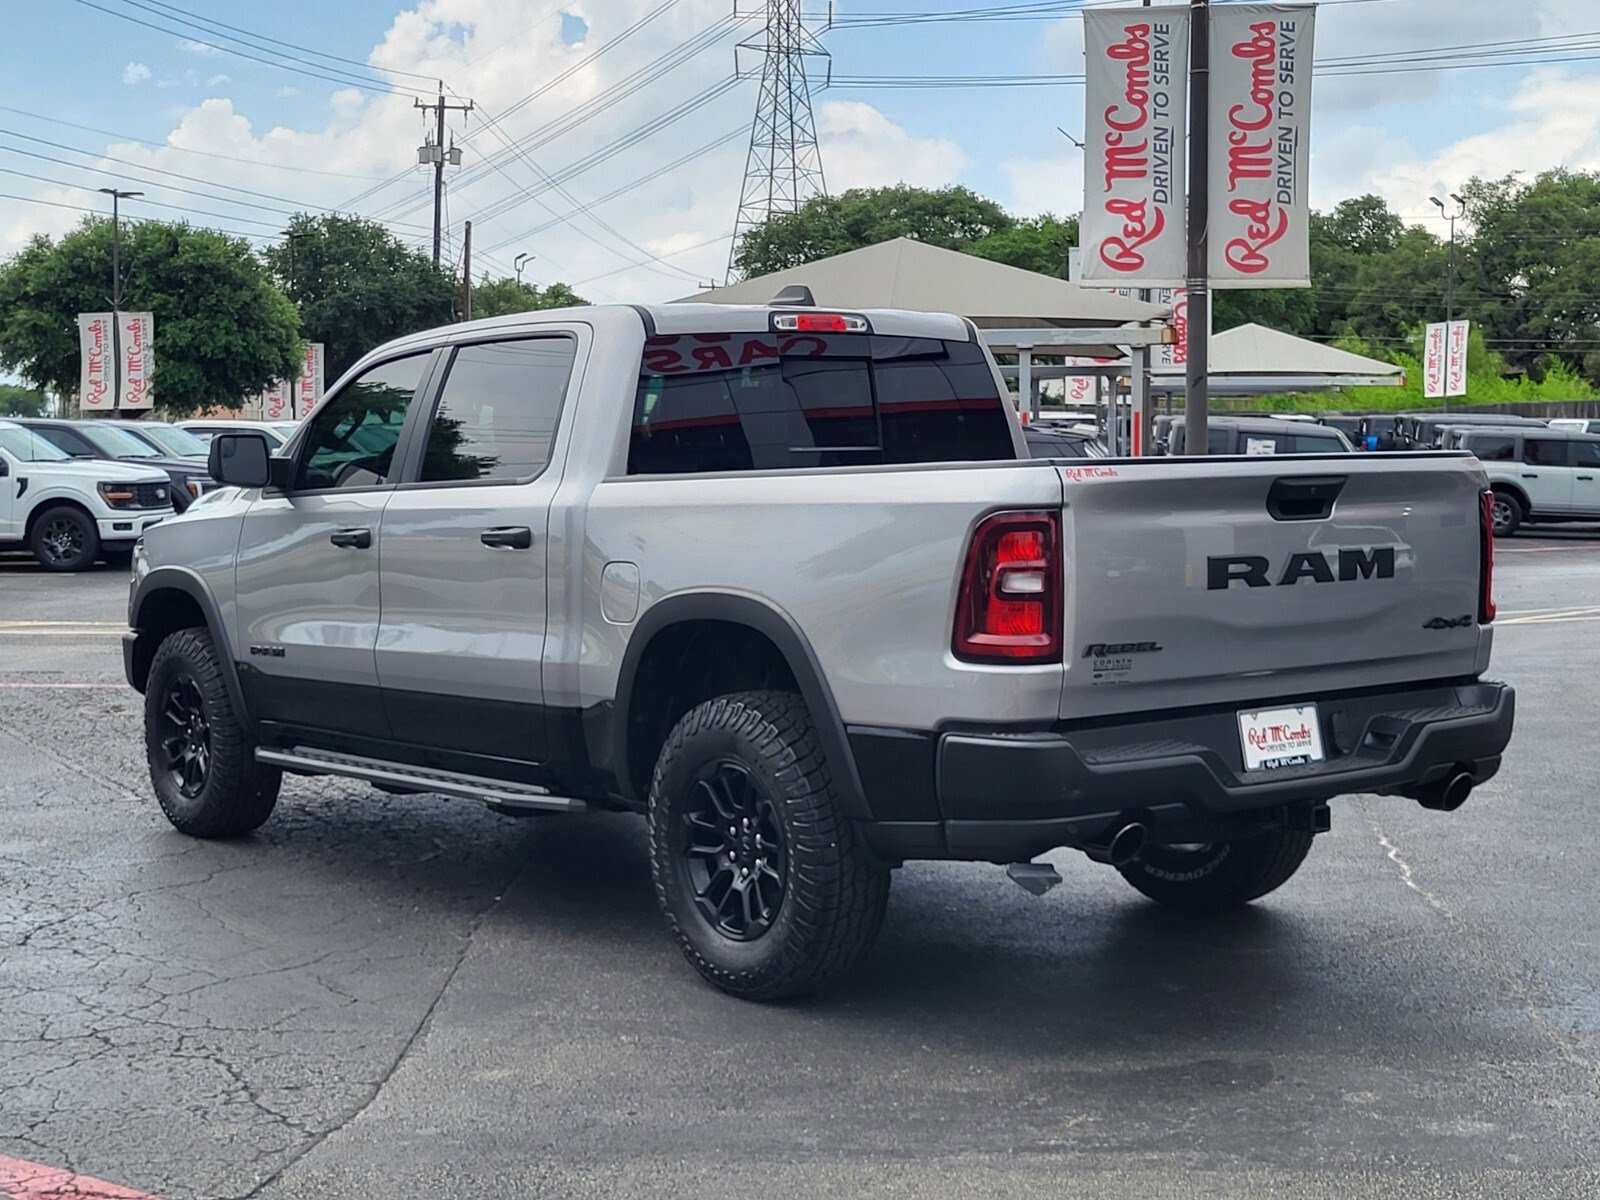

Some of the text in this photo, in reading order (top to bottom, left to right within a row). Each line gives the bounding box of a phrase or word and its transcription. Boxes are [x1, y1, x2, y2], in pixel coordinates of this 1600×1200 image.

[1153, 23, 1170, 204] DRIVEN TO SERVE
[1277, 21, 1296, 205] DRIVEN TO SERVE
[1100, 23, 1164, 272] Red McCombs
[1225, 21, 1288, 273] Red McCombs
[86, 319, 108, 404] Red McCombs
[126, 318, 147, 403] Red McCombs
[1071, 378, 1089, 399] Red
[268, 397, 285, 418] Red
[1207, 545, 1395, 591] RAM
[1081, 641, 1163, 659] REBEL
[1422, 614, 1473, 630] 4x4
[1248, 723, 1312, 751] Red McCombs
